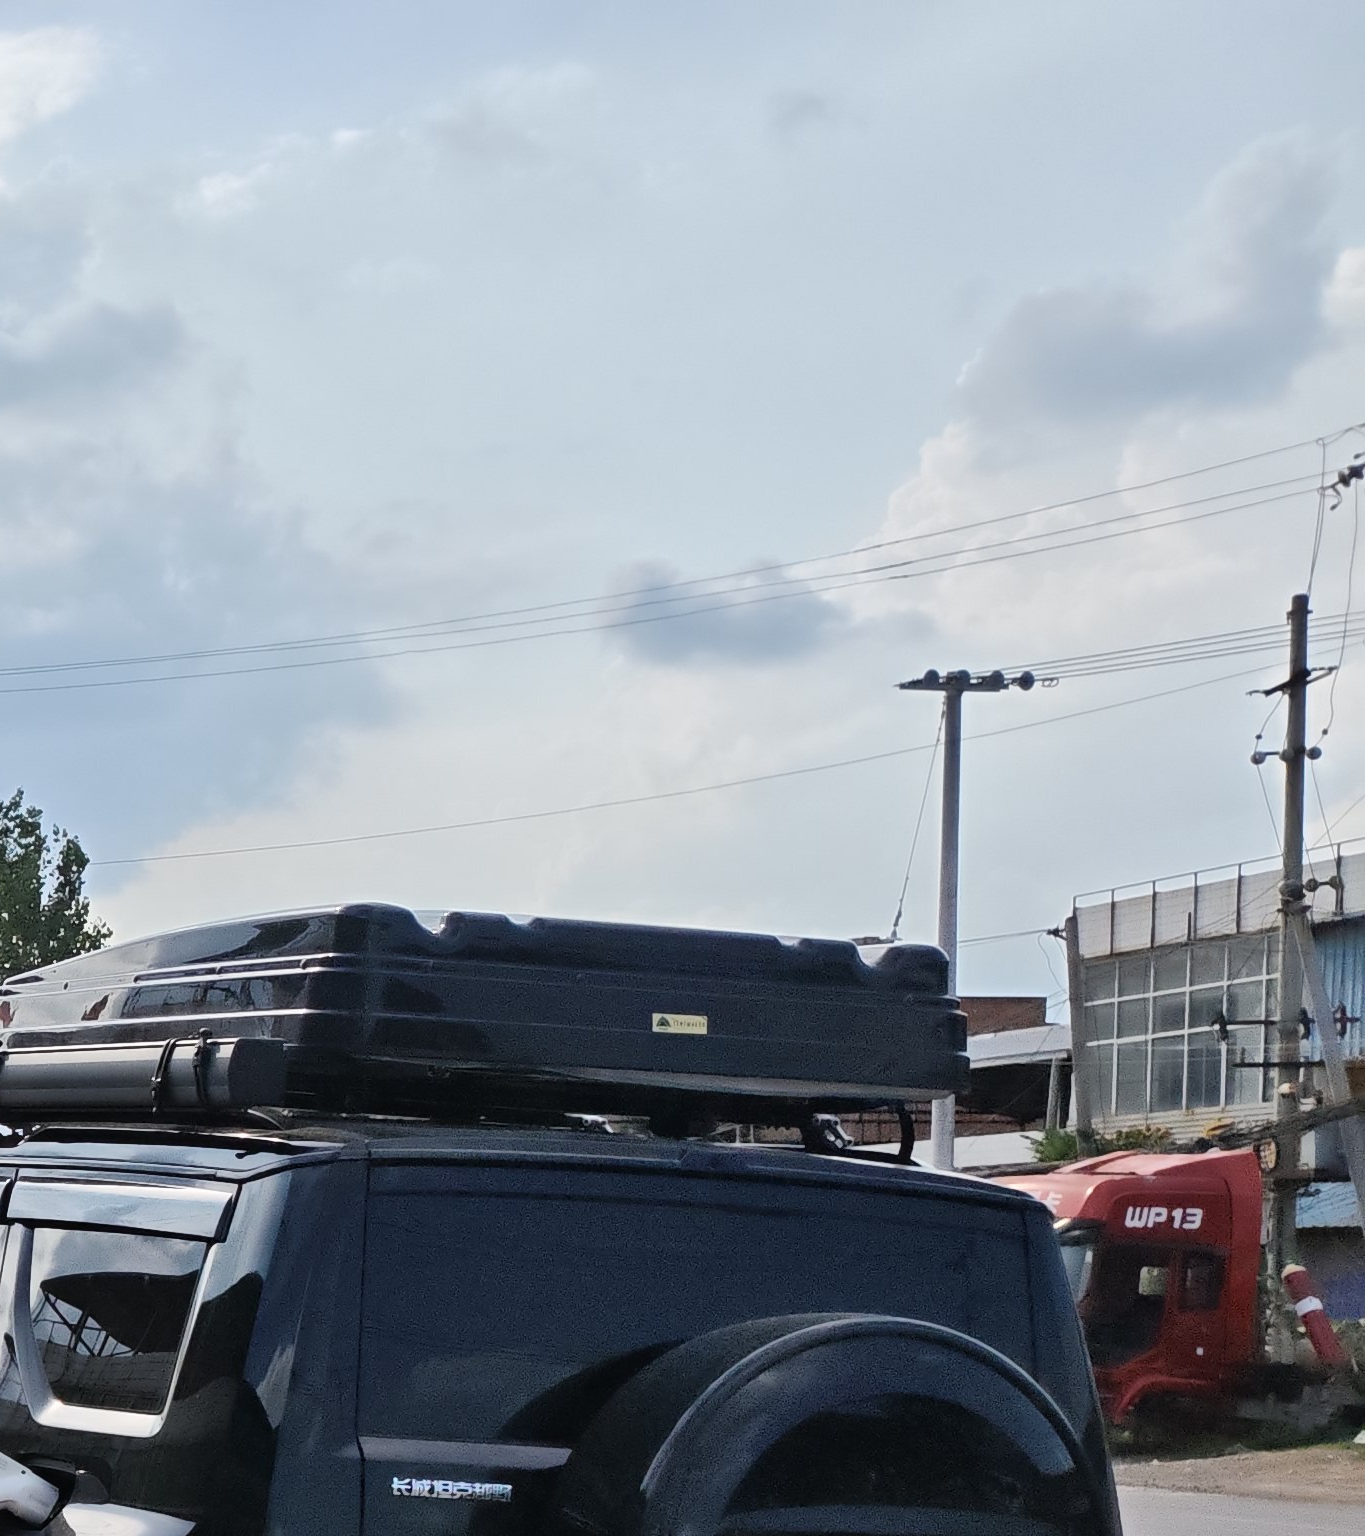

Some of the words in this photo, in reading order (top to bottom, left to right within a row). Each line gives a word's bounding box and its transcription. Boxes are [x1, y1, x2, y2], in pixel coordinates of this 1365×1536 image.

[391, 1476, 513, 1503] 长城坦克越野
